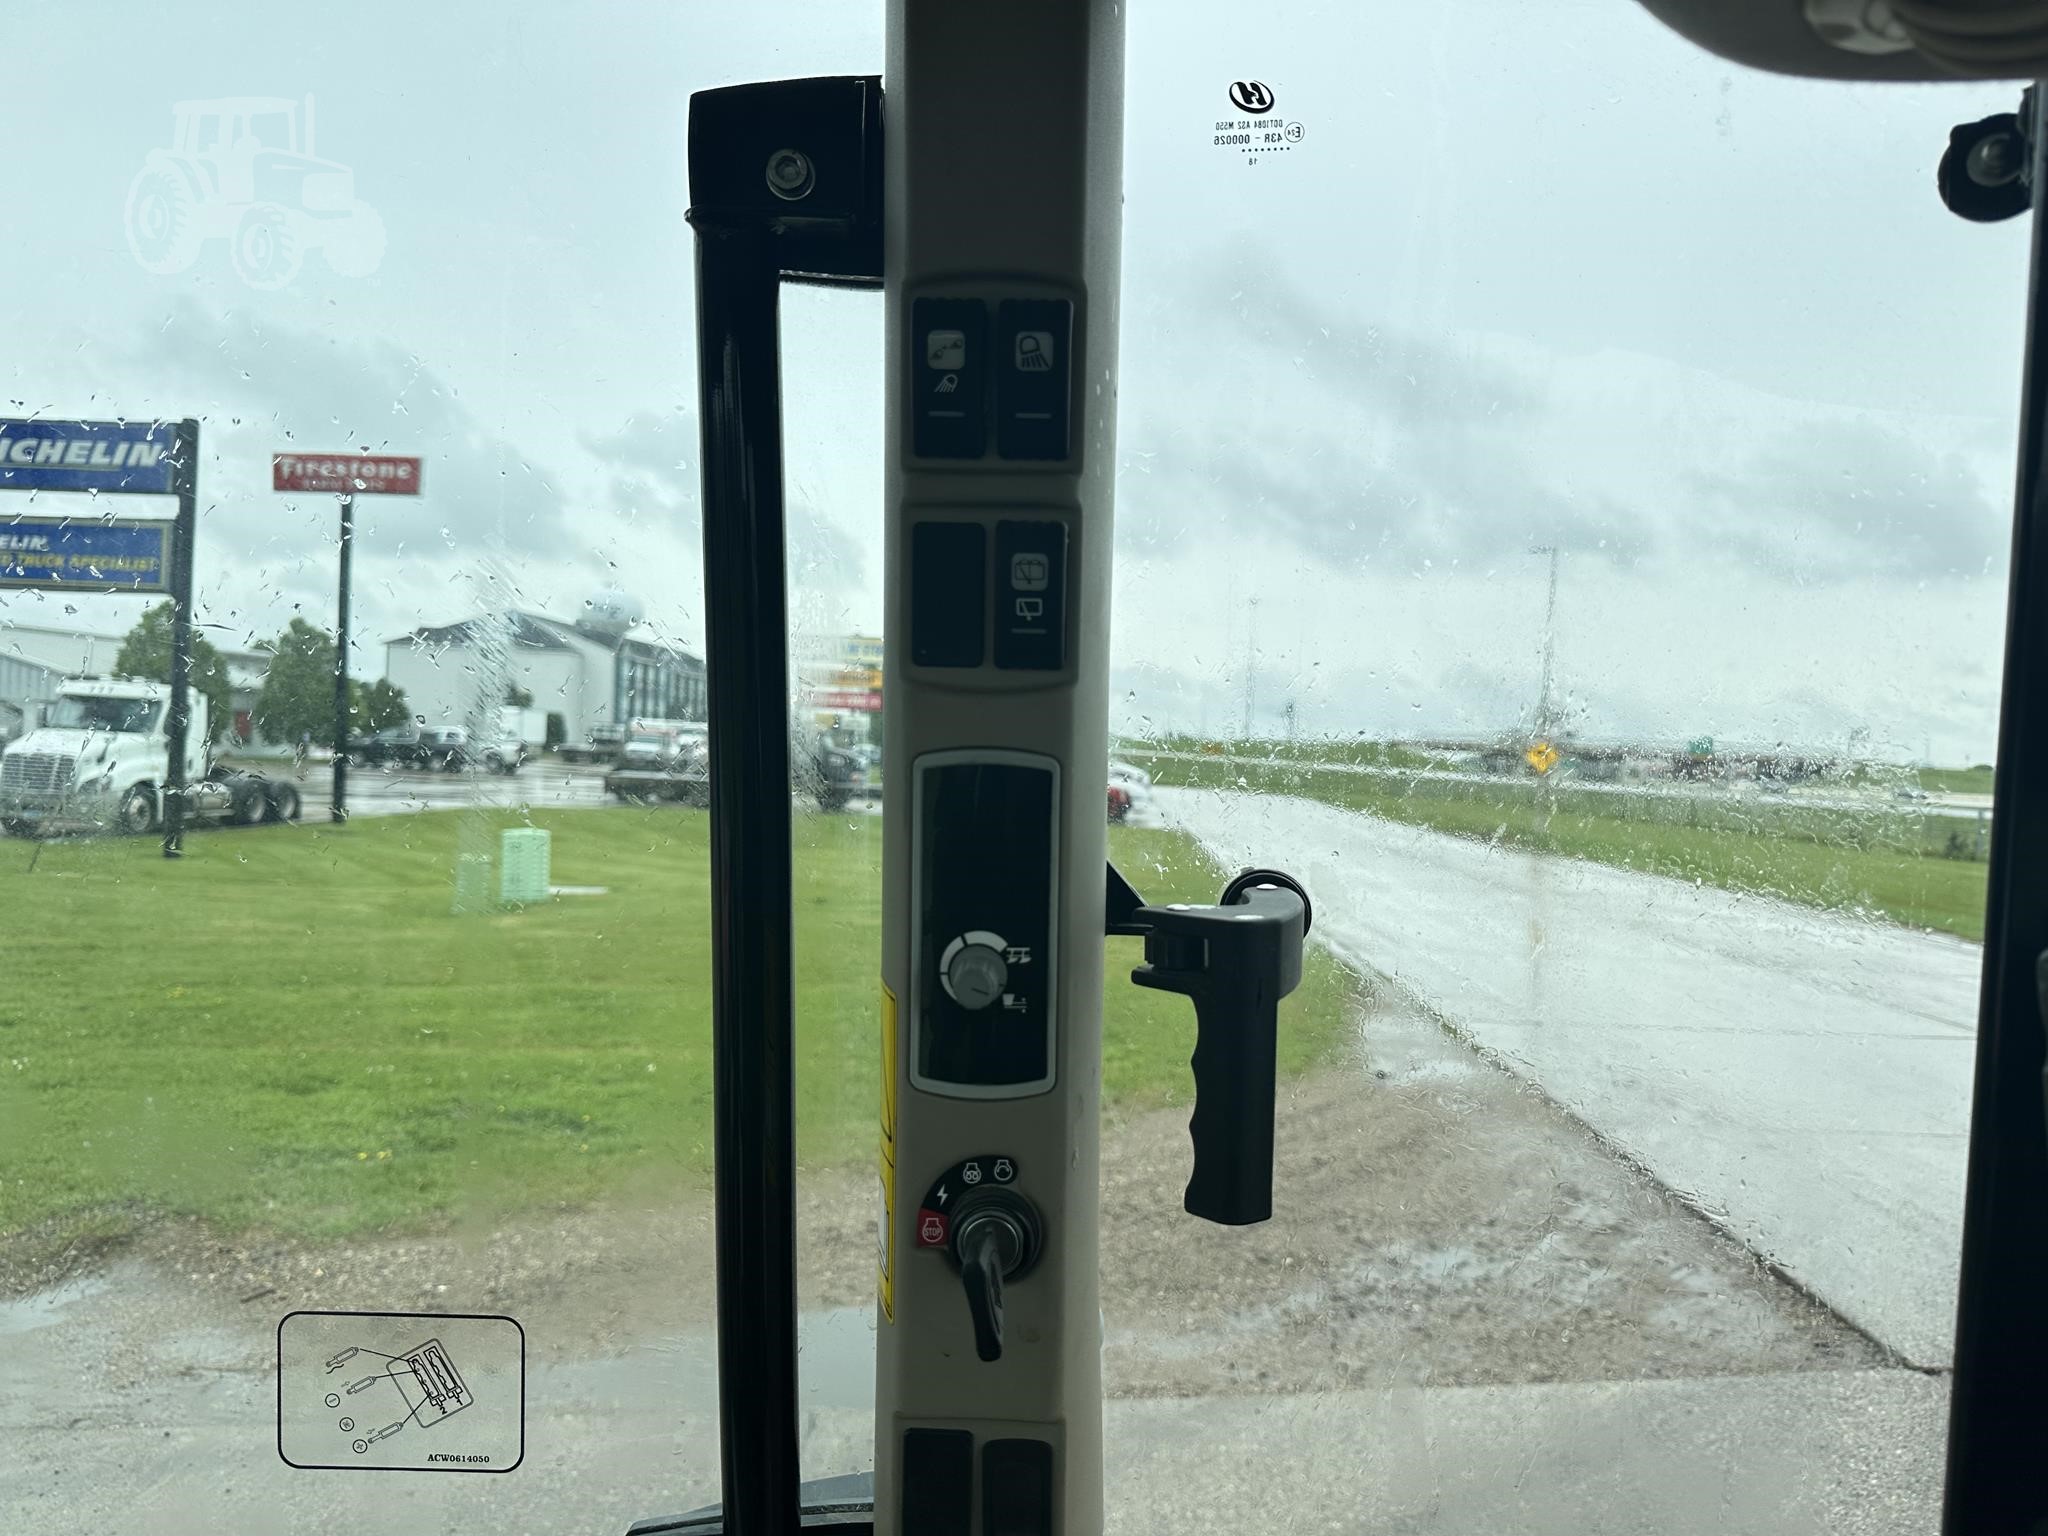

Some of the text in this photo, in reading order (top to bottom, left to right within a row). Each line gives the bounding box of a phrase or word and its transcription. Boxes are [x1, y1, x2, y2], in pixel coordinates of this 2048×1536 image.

[280, 455, 412, 480] Firestone
[18, 553, 65, 568] TRUCK
[69, 554, 159, 572] SPECIALIST
[925, 1228, 940, 1236] STOP
[427, 1453, 490, 1463] ACW0614050
